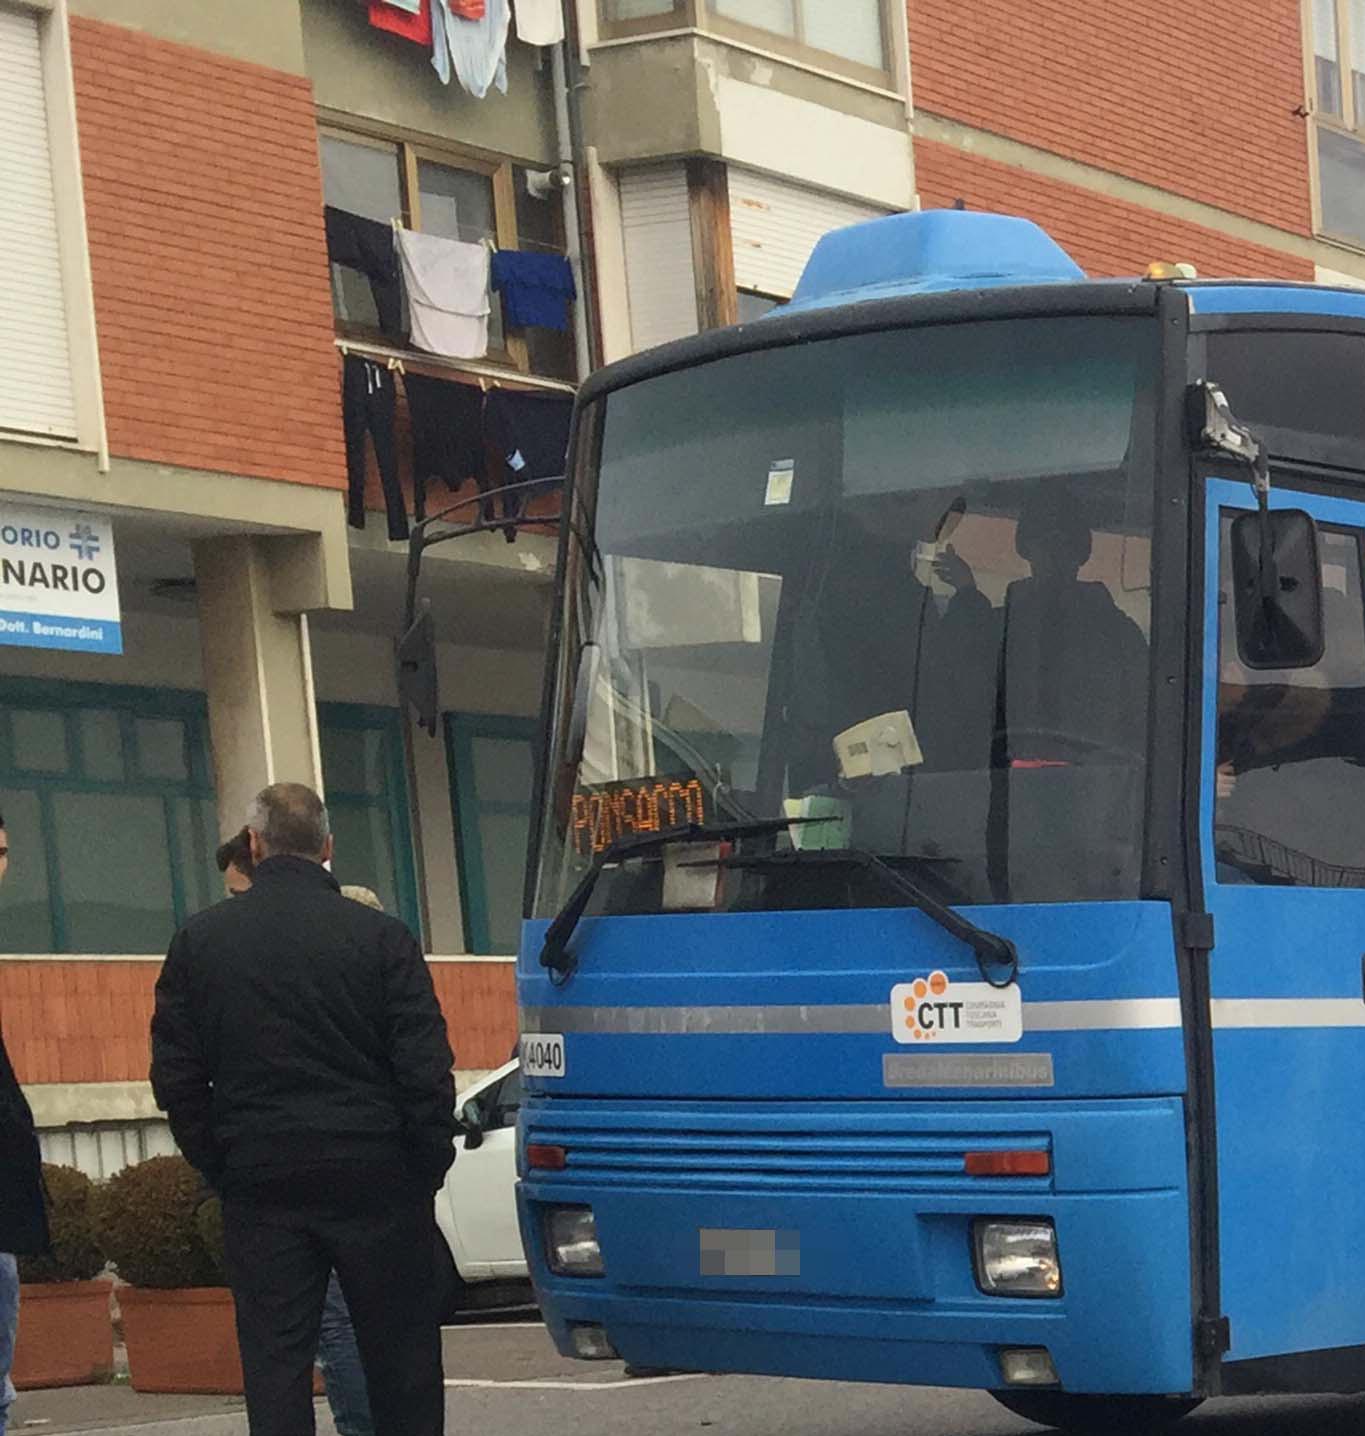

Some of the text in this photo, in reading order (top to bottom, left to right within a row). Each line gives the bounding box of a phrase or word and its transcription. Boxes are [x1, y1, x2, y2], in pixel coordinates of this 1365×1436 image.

[1, 525, 61, 550] ORIO
[1, 558, 106, 594] NARIO
[33, 621, 104, 641] Bernardini
[918, 1002, 964, 1029] CTT
